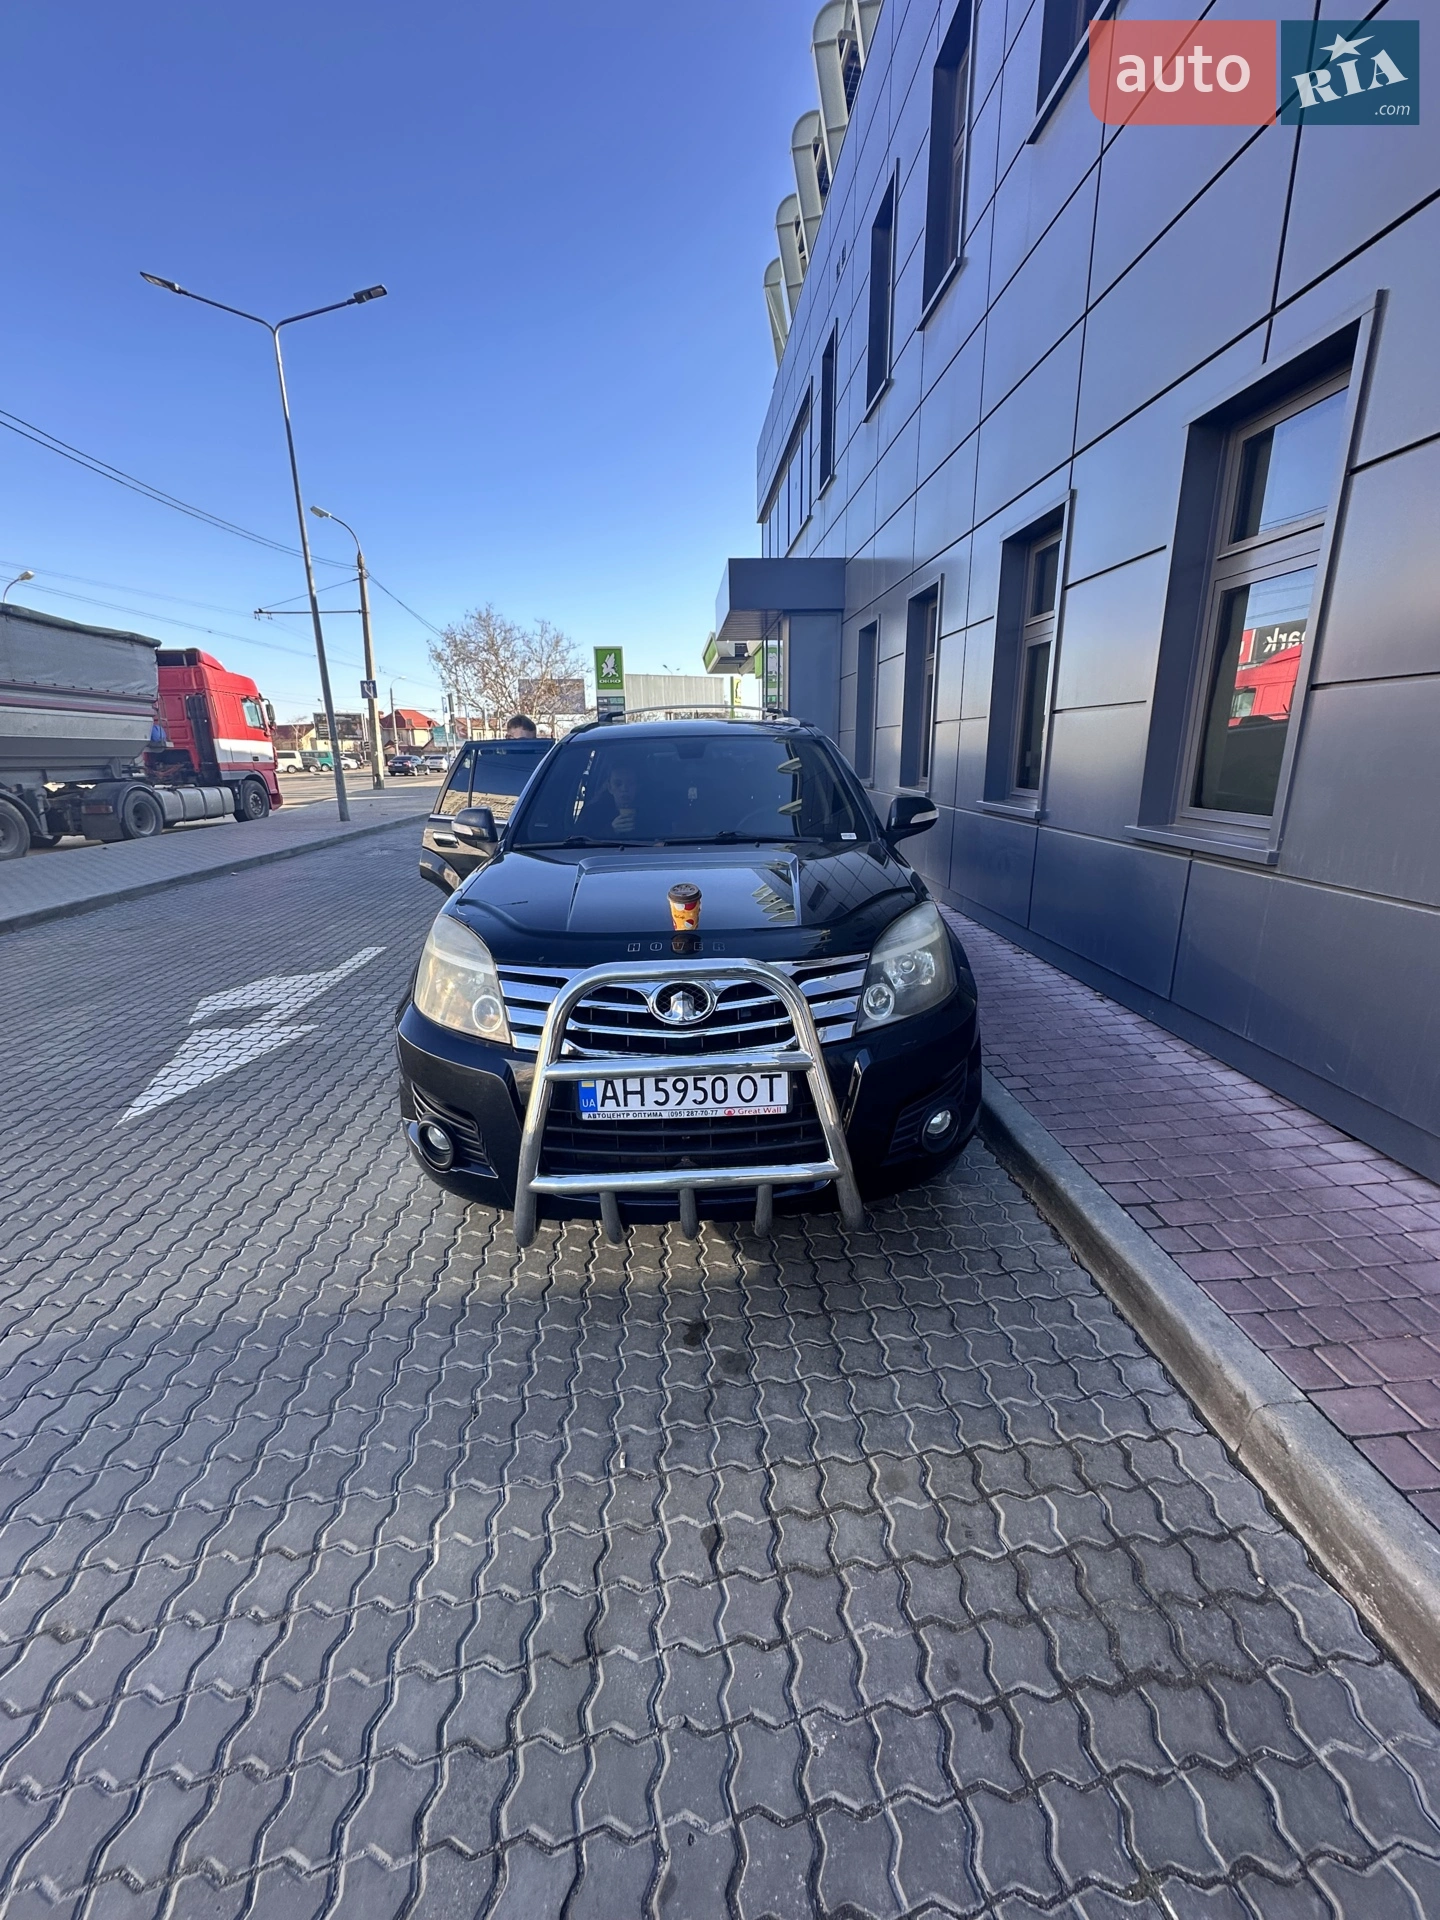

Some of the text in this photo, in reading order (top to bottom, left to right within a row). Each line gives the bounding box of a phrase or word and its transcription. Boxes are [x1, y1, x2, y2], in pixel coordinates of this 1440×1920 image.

[627, 941, 725, 952] HOVER
[653, 1075, 729, 1106] 5950
[582, 1098, 596, 1108] UA
[686, 1109, 719, 1117] 287-70-77
